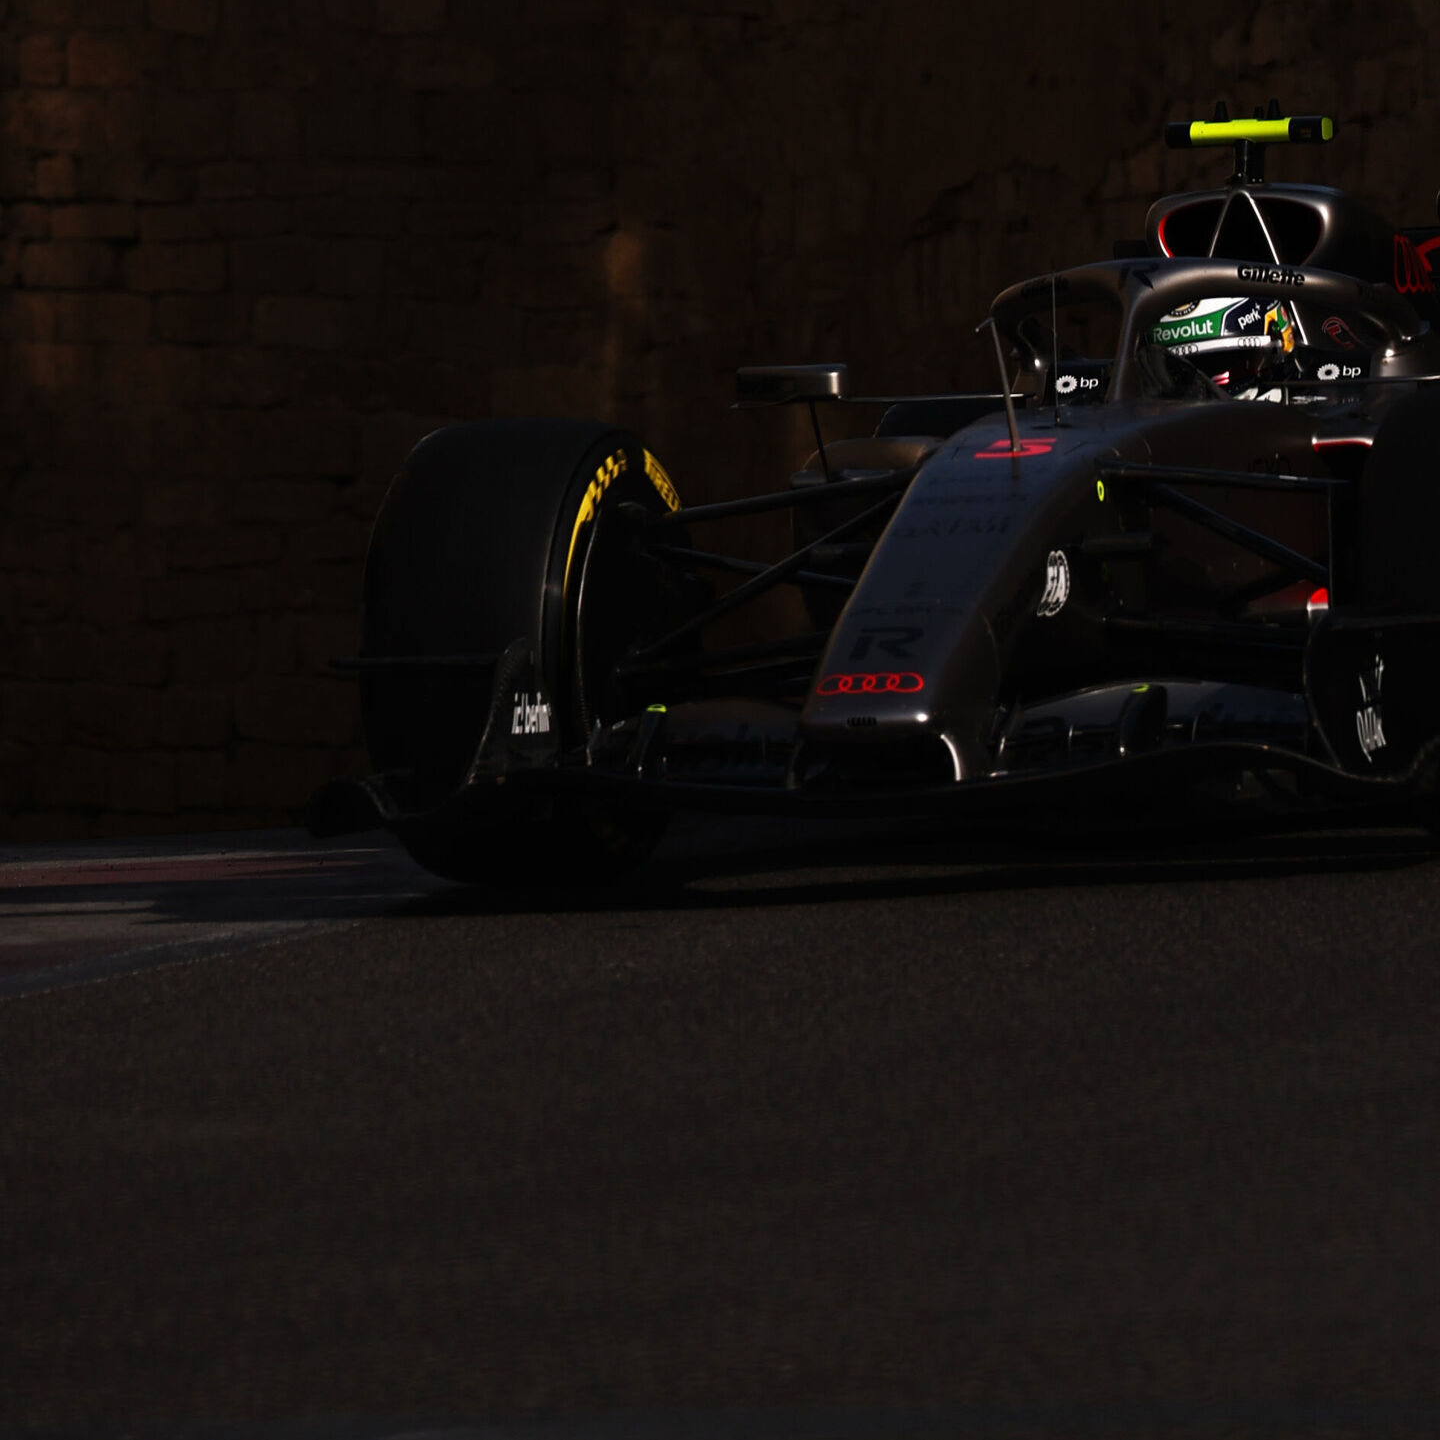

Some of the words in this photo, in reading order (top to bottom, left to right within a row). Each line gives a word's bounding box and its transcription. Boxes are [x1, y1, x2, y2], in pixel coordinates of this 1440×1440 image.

[1237, 264, 1305, 287] Gillette
[1152, 318, 1214, 345] Revolut
[1079, 376, 1099, 390] bp
[1342, 365, 1362, 379] bp
[973, 437, 1058, 460] 5
